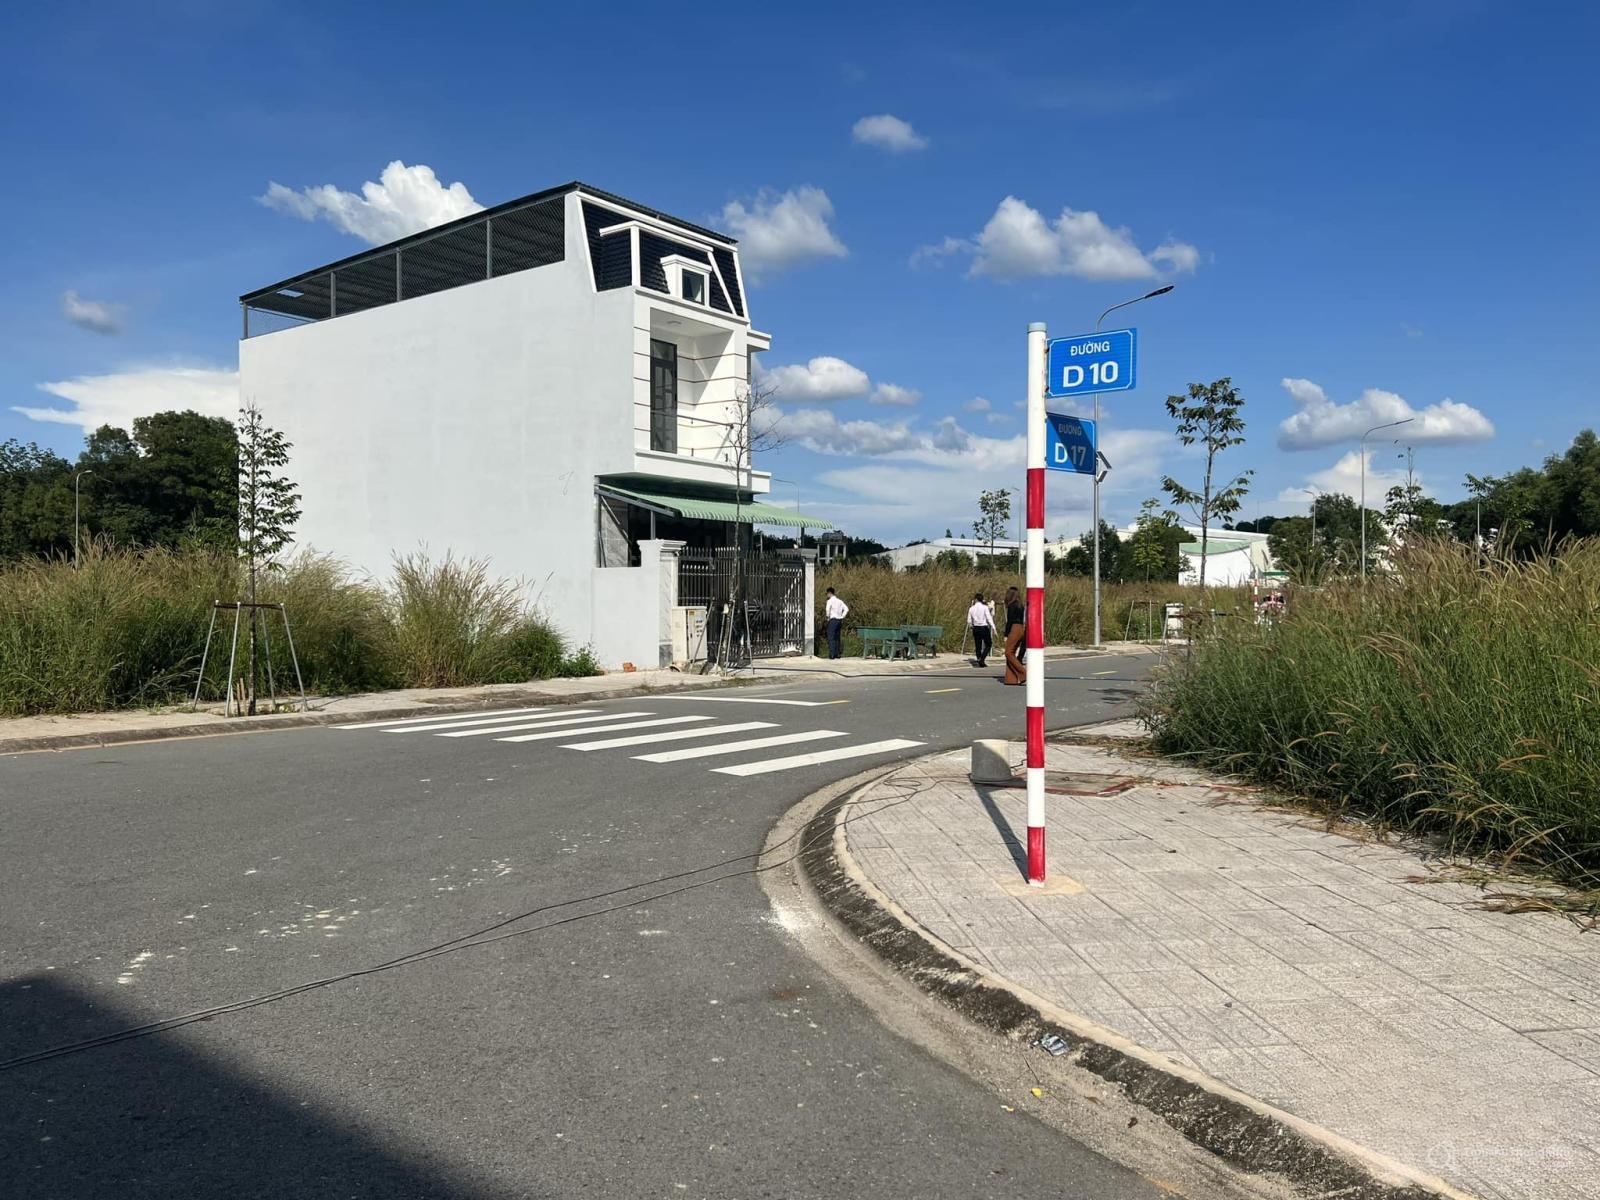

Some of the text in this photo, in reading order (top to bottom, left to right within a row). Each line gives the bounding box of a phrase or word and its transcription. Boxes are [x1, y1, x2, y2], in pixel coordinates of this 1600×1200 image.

[1070, 340, 1110, 356] ĐƯỜNG
[1063, 360, 1119, 388] D 10
[1054, 442, 1087, 467] D 17
